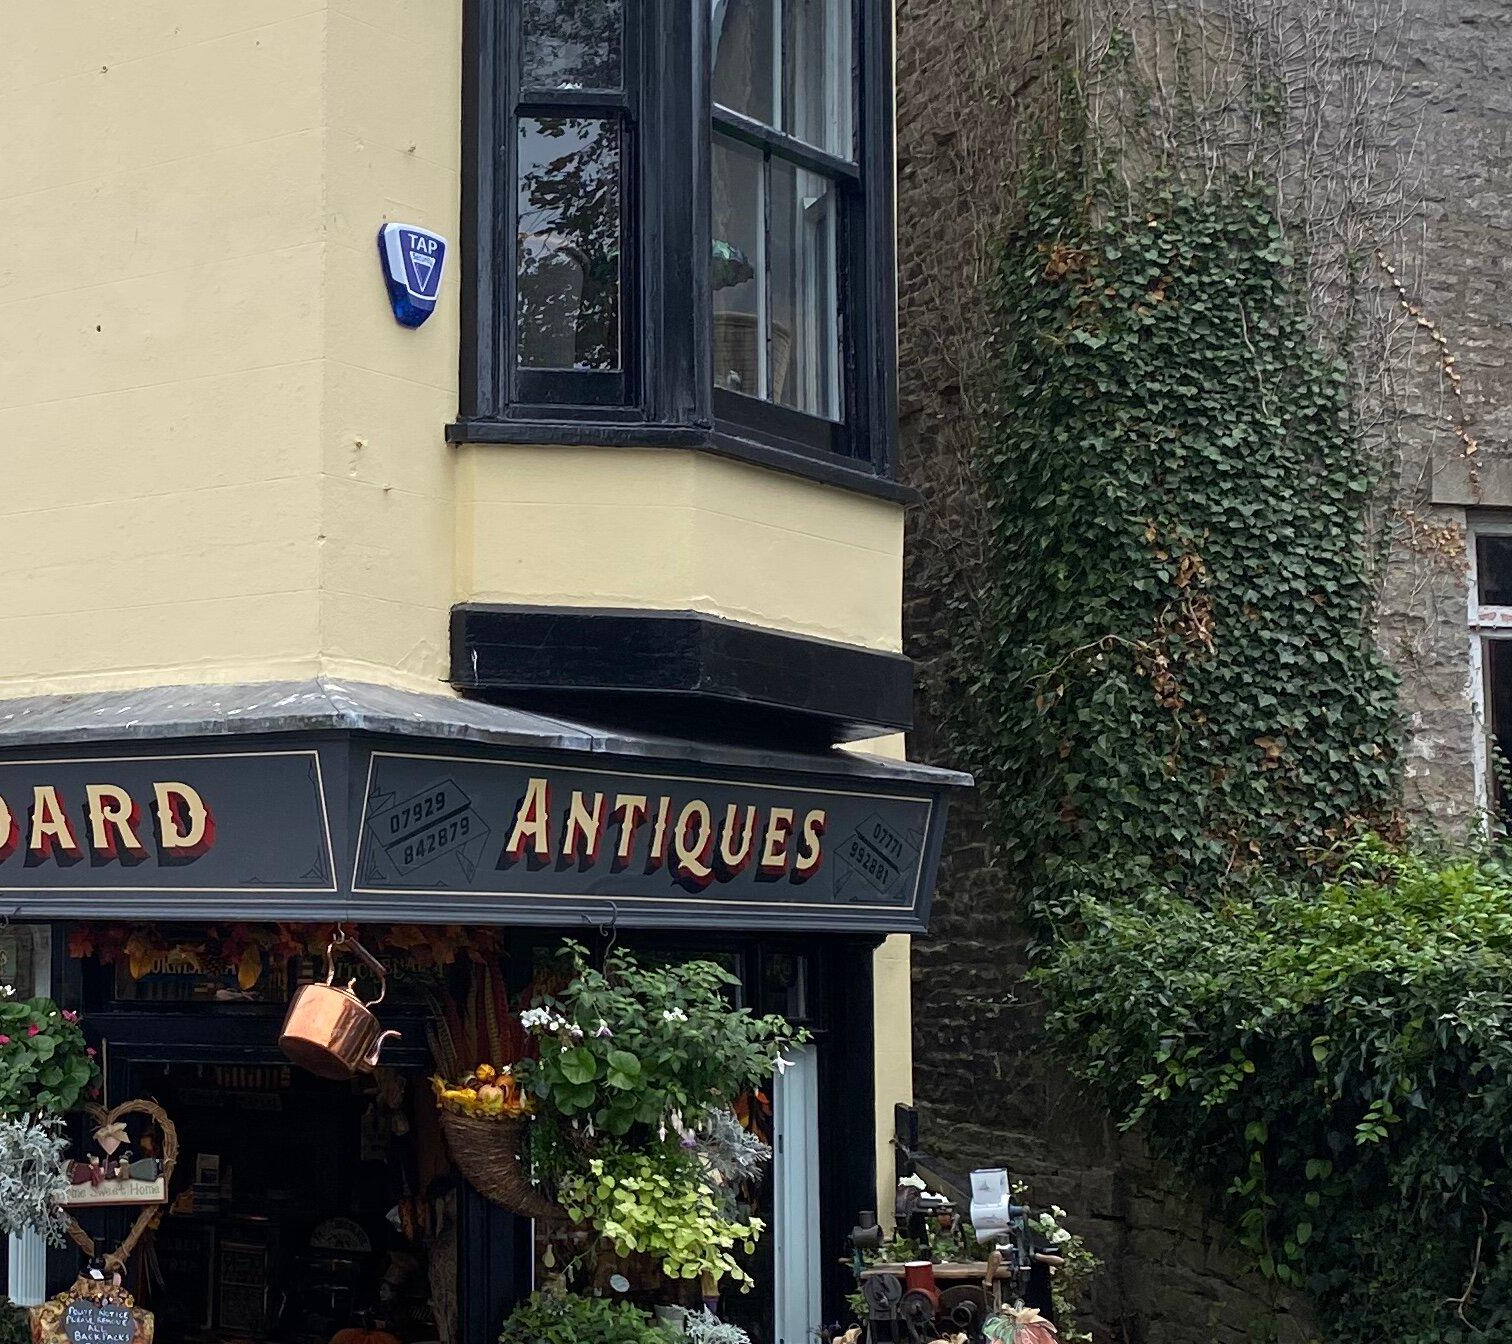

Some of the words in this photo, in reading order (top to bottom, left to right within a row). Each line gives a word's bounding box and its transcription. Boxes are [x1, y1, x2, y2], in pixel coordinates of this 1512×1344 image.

[408, 233, 438, 254] TAP
[390, 791, 446, 834] 07929
[497, 777, 827, 888] ANTIQUES
[404, 816, 470, 865] 842879
